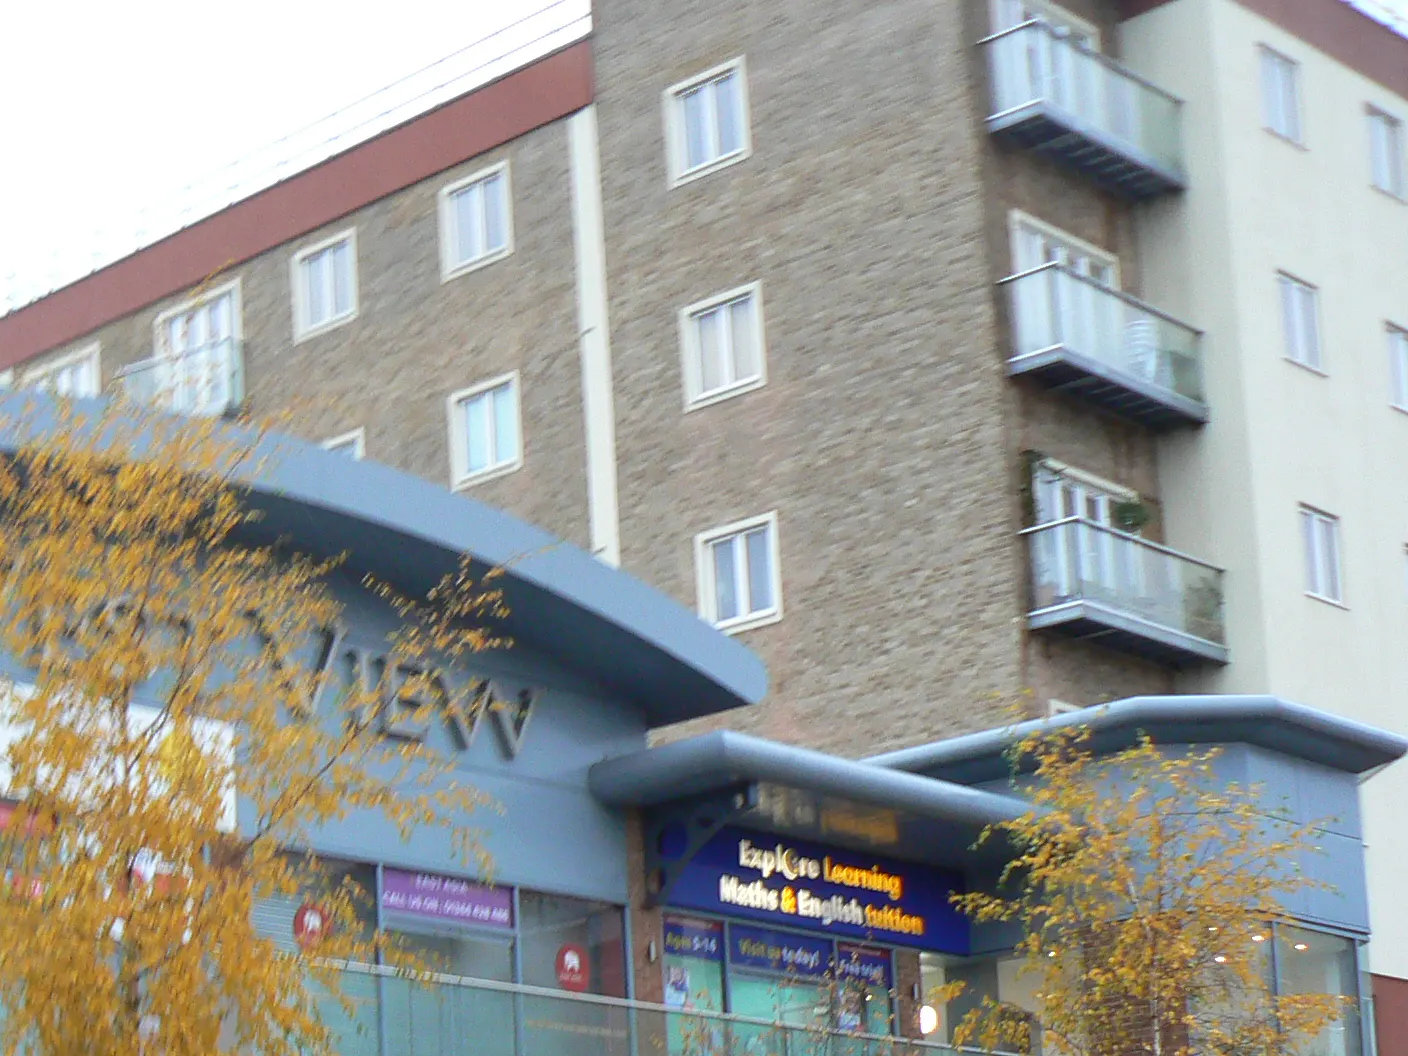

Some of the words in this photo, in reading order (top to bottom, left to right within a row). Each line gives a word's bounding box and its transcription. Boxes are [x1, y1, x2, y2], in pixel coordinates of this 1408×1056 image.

[738, 839, 821, 880] Explore
[823, 855, 904, 900] Learning
[719, 873, 778, 911] Maths
[780, 886, 797, 914] &
[797, 888, 864, 925] English
[865, 904, 925, 935] tuition
